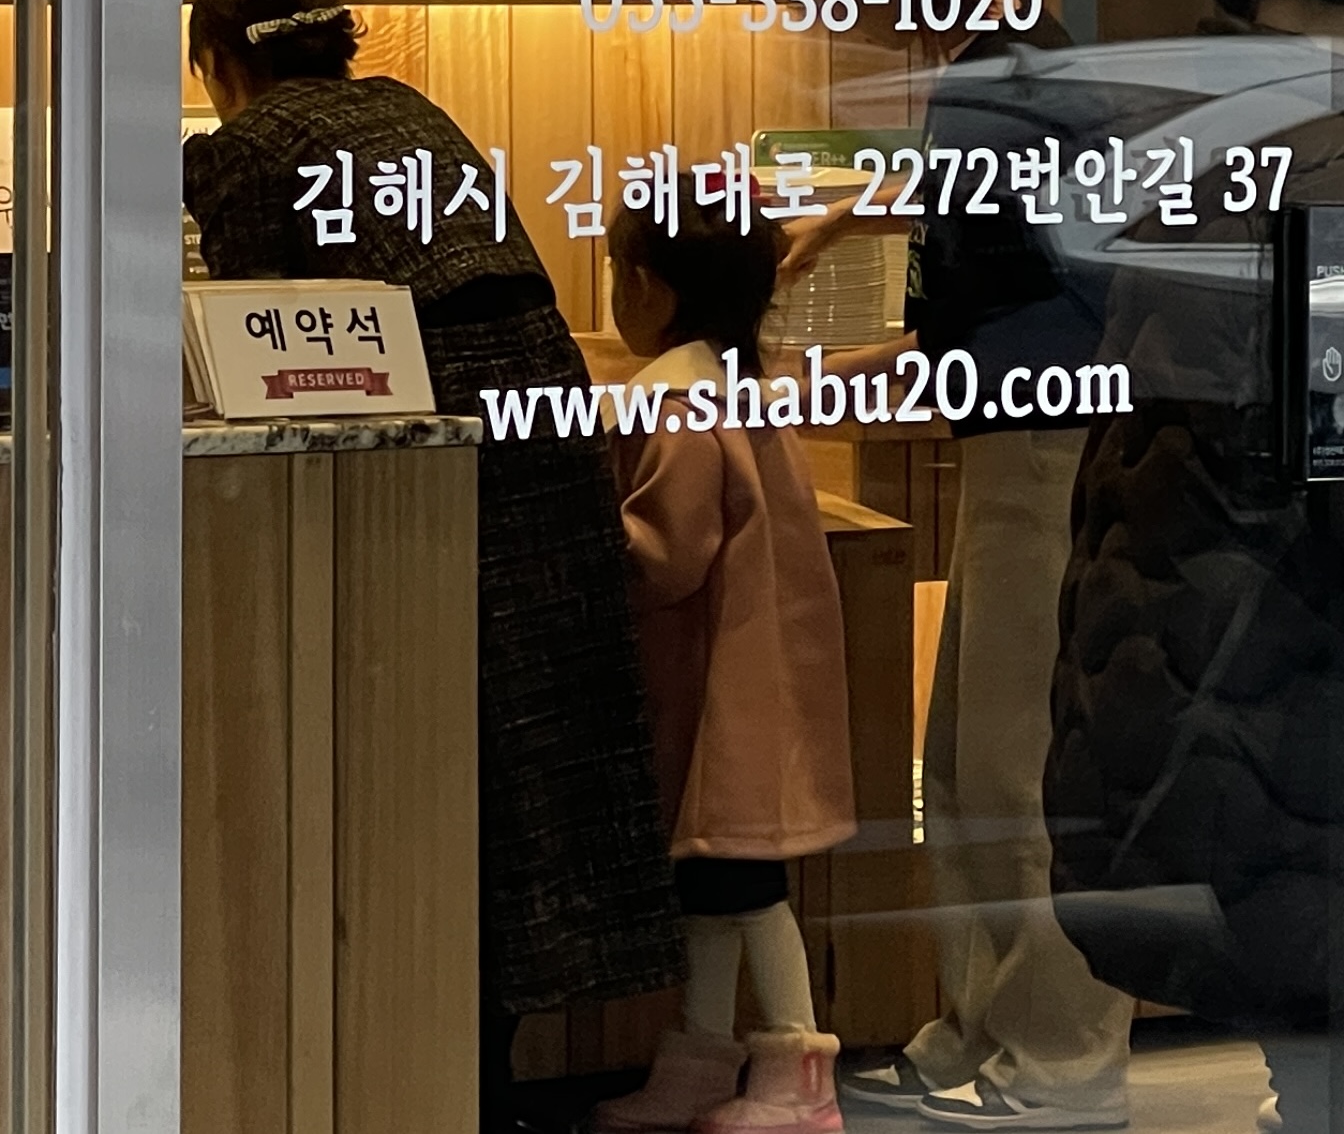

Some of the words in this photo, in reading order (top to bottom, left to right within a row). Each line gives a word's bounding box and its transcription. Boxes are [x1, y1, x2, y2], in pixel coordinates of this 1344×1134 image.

[293, 146, 507, 246] 김해시
[545, 141, 828, 240] 김해대로
[853, 135, 1199, 226] 2272번안길
[1223, 145, 1294, 213] 37
[244, 304, 386, 356] 예약석
[287, 369, 366, 391] RESERVED
[480, 344, 1134, 442] www.shabu20.com
